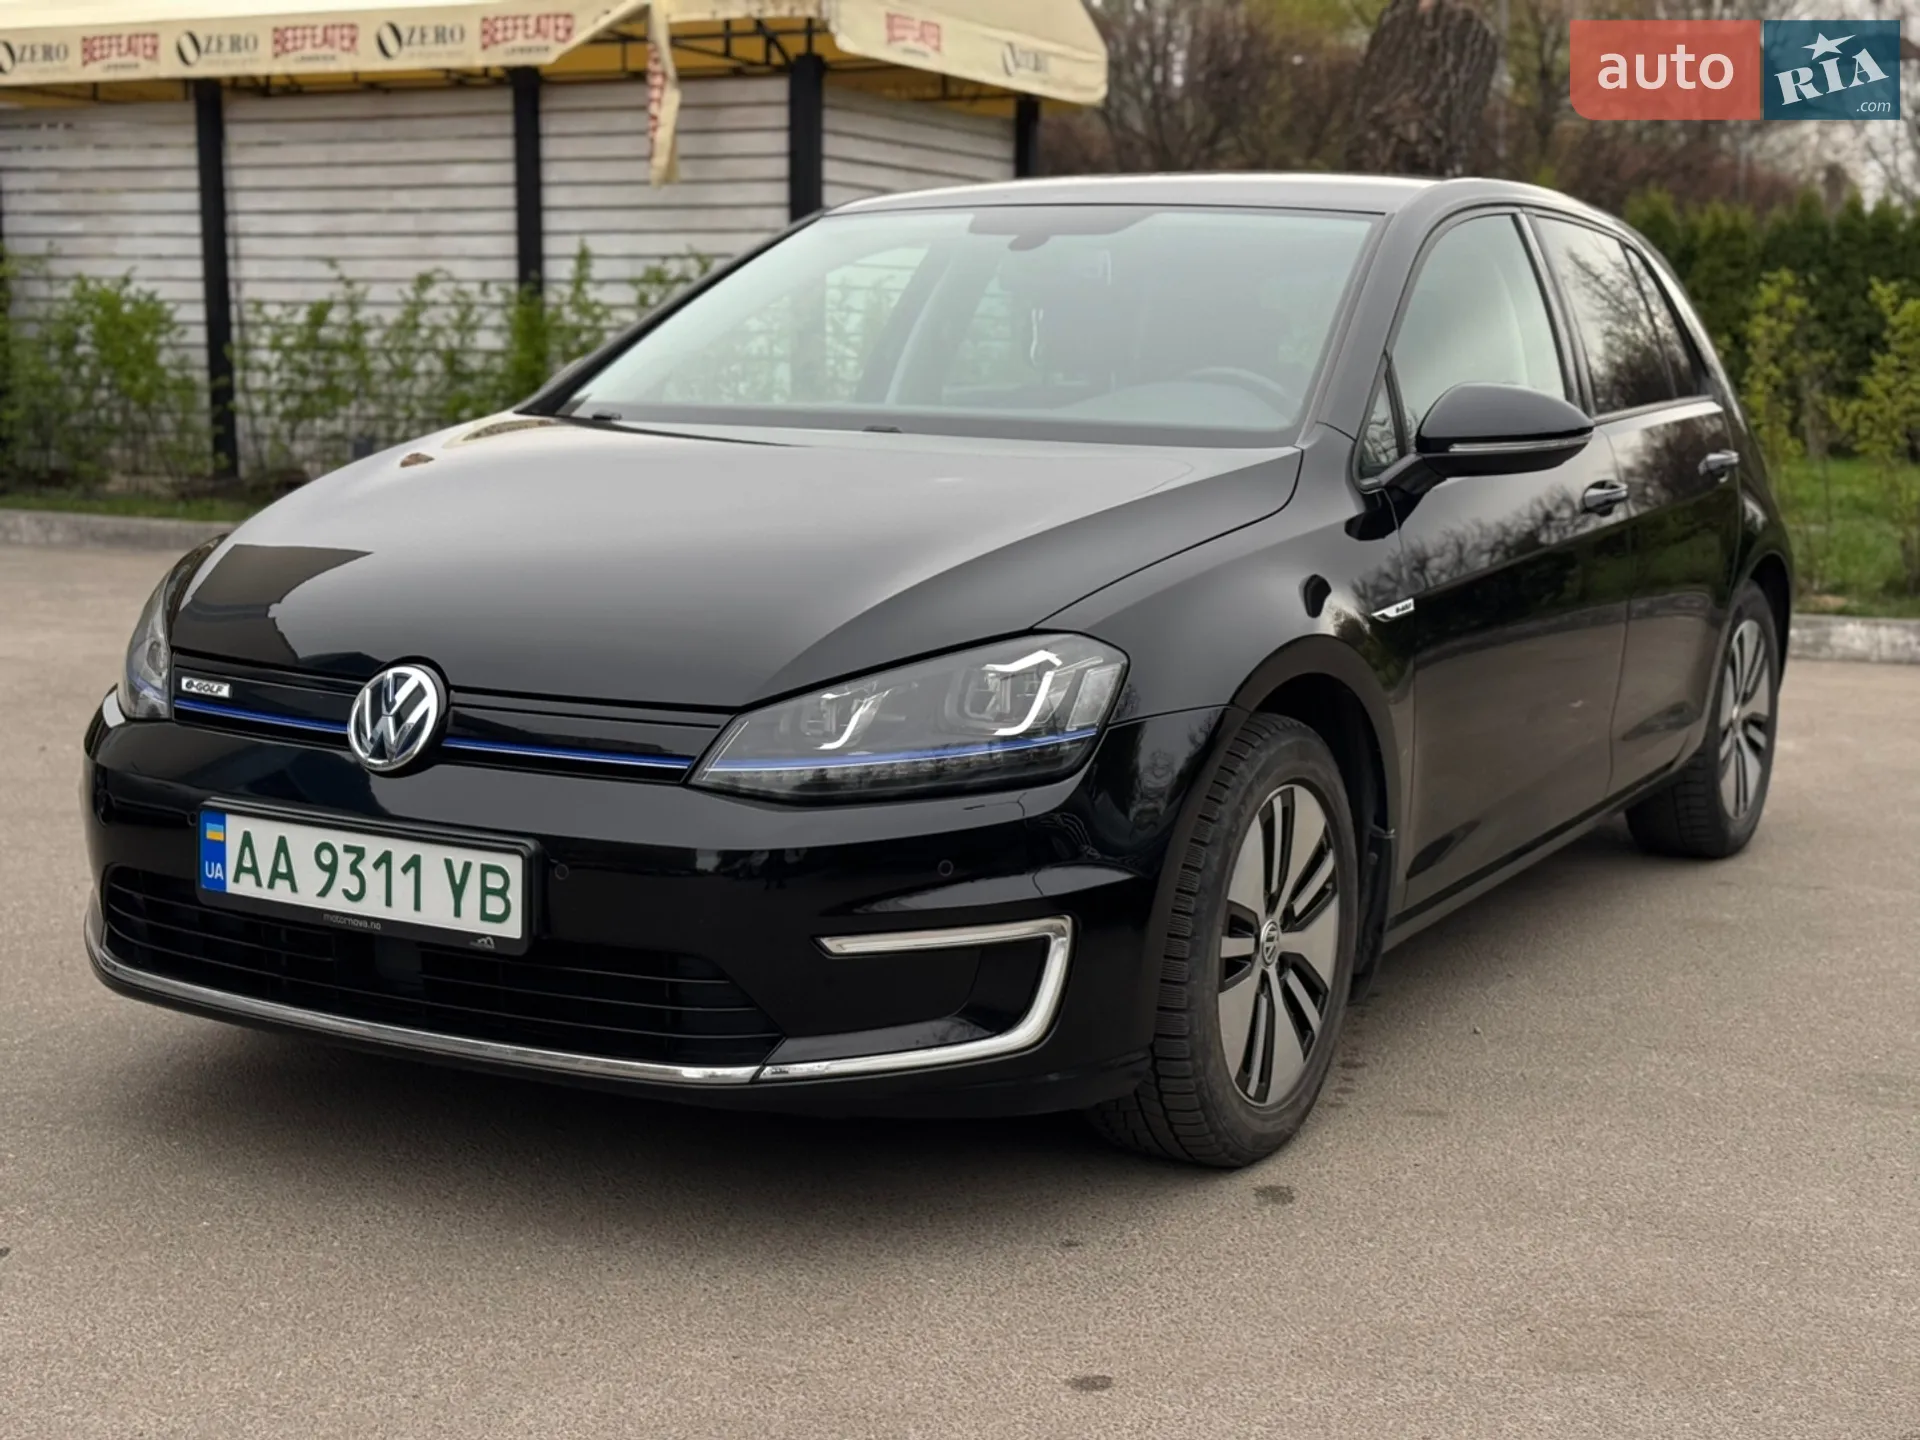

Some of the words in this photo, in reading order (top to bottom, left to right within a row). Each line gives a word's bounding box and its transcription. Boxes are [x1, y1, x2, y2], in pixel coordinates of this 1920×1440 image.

[205, 862, 225, 881] UA
[232, 830, 299, 894] AA
[313, 841, 422, 912] 9311
[443, 857, 512, 925] YB
